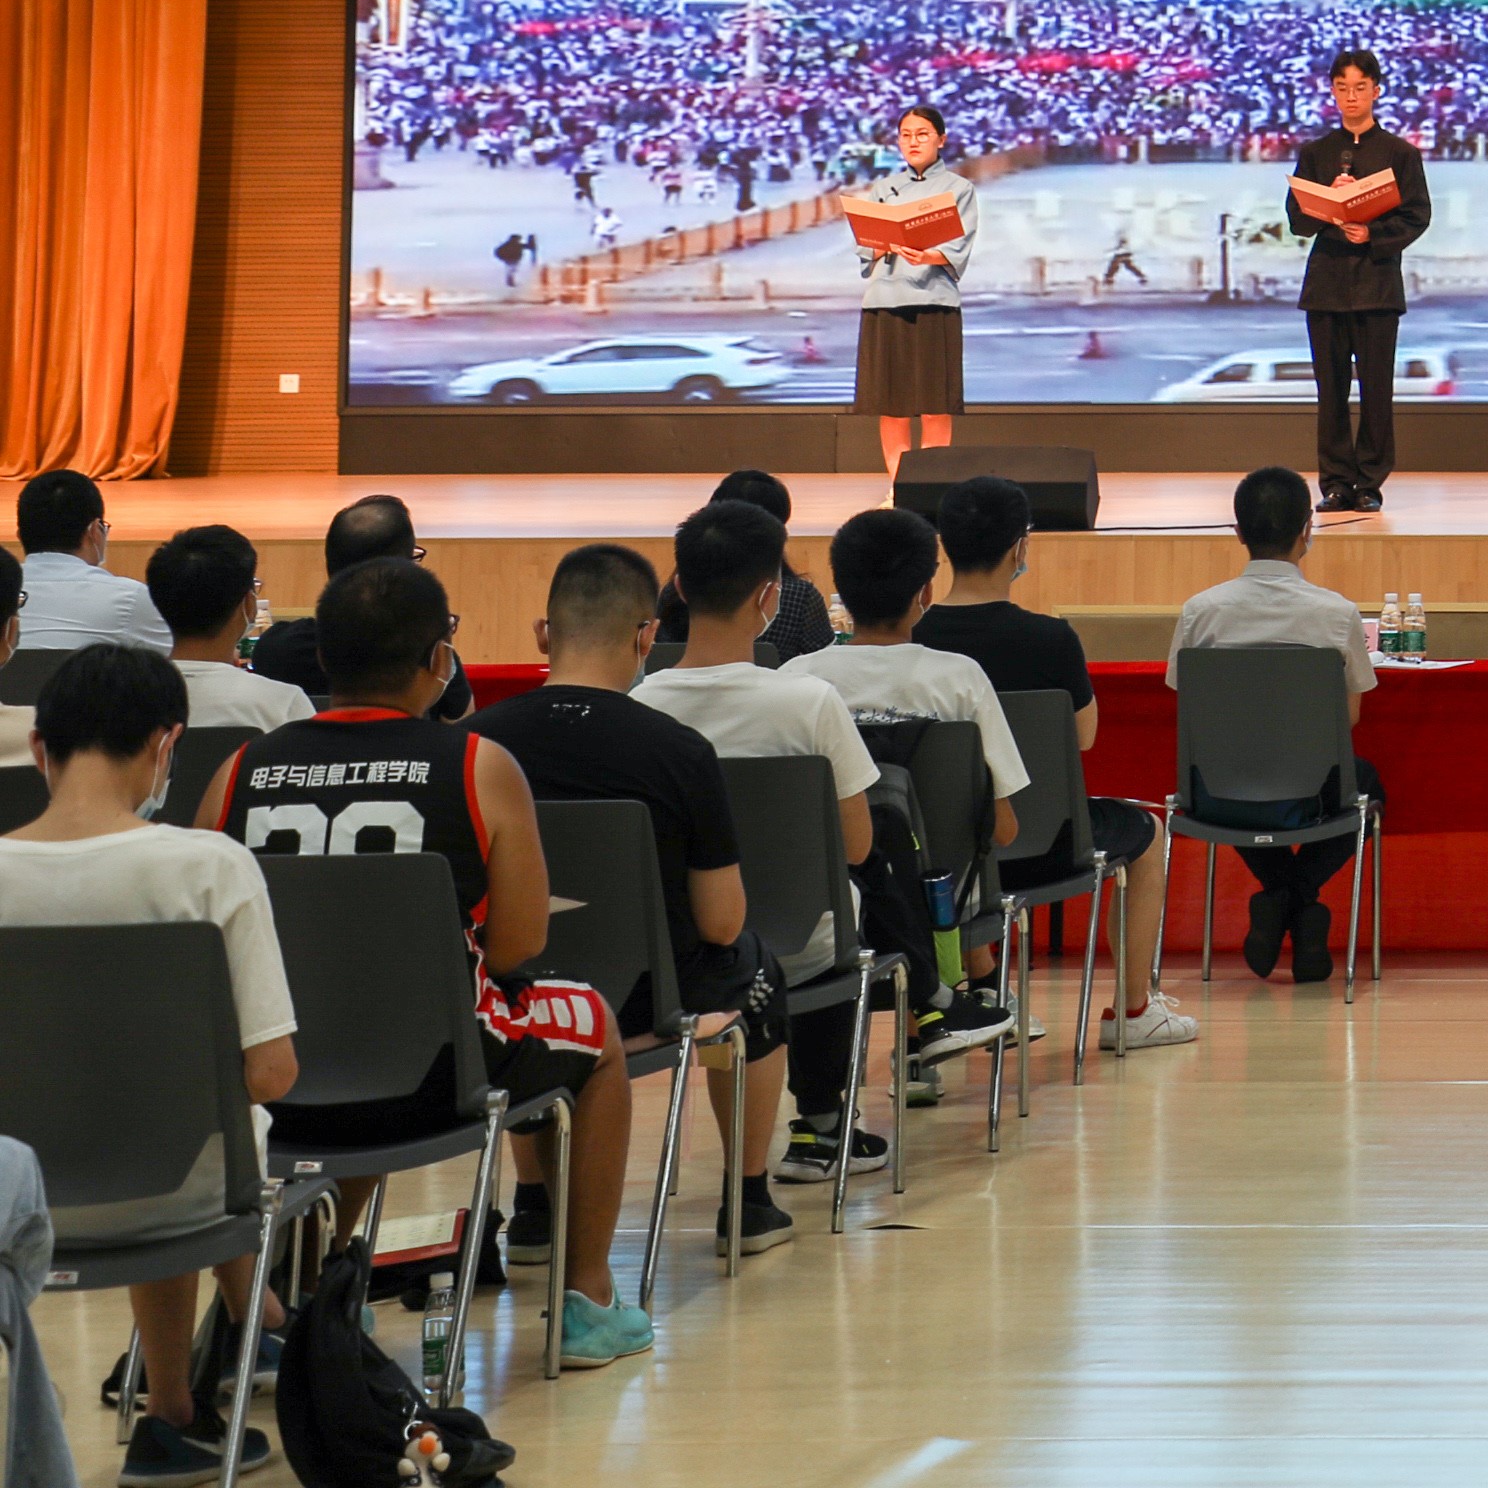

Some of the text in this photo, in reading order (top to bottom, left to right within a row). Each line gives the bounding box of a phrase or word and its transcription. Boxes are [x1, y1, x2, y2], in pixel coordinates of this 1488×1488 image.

[250, 760, 430, 789] 电子与信息工程学院
